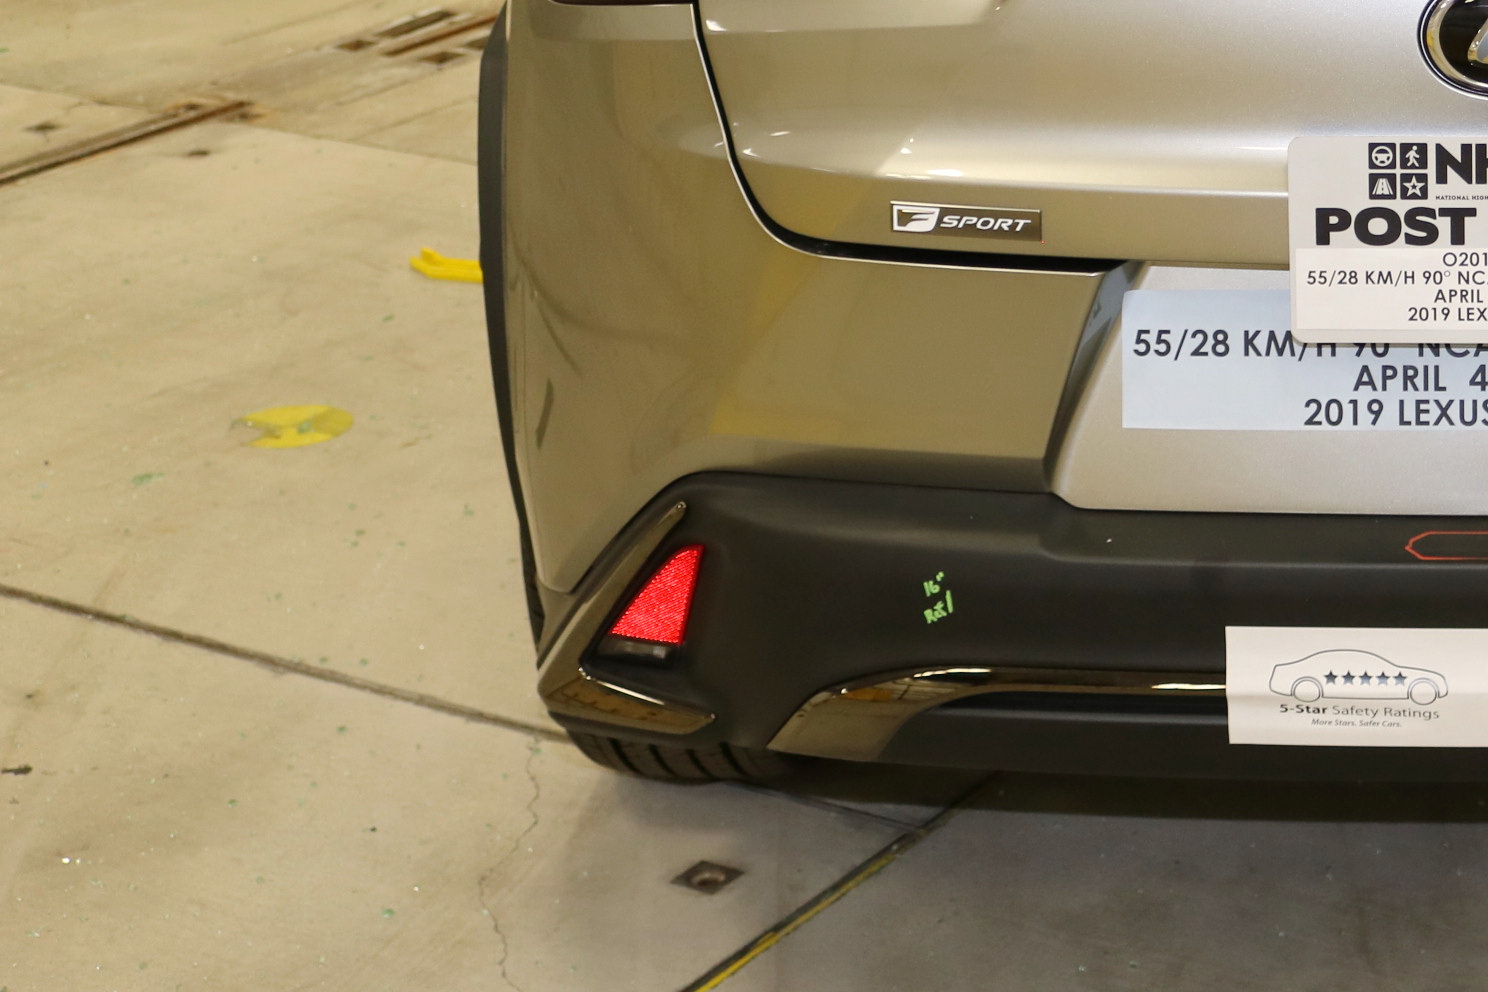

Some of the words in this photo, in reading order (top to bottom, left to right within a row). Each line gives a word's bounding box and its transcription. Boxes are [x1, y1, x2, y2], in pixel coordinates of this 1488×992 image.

[940, 215, 1031, 232] SPORT
[1315, 206, 1478, 247] POST
[1307, 270, 1359, 287] 55/28
[1365, 270, 1415, 287] KM/H
[1433, 288, 1484, 304] APRIL
[1408, 306, 1451, 322] 2019
[1133, 328, 1230, 361] 55/28
[1353, 364, 1447, 392] APRIL
[1303, 398, 1384, 427] 2019
[1279, 704, 1328, 714] 5-Star
[1332, 706, 1379, 718] Safety
[1383, 708, 1440, 721] Ratings
